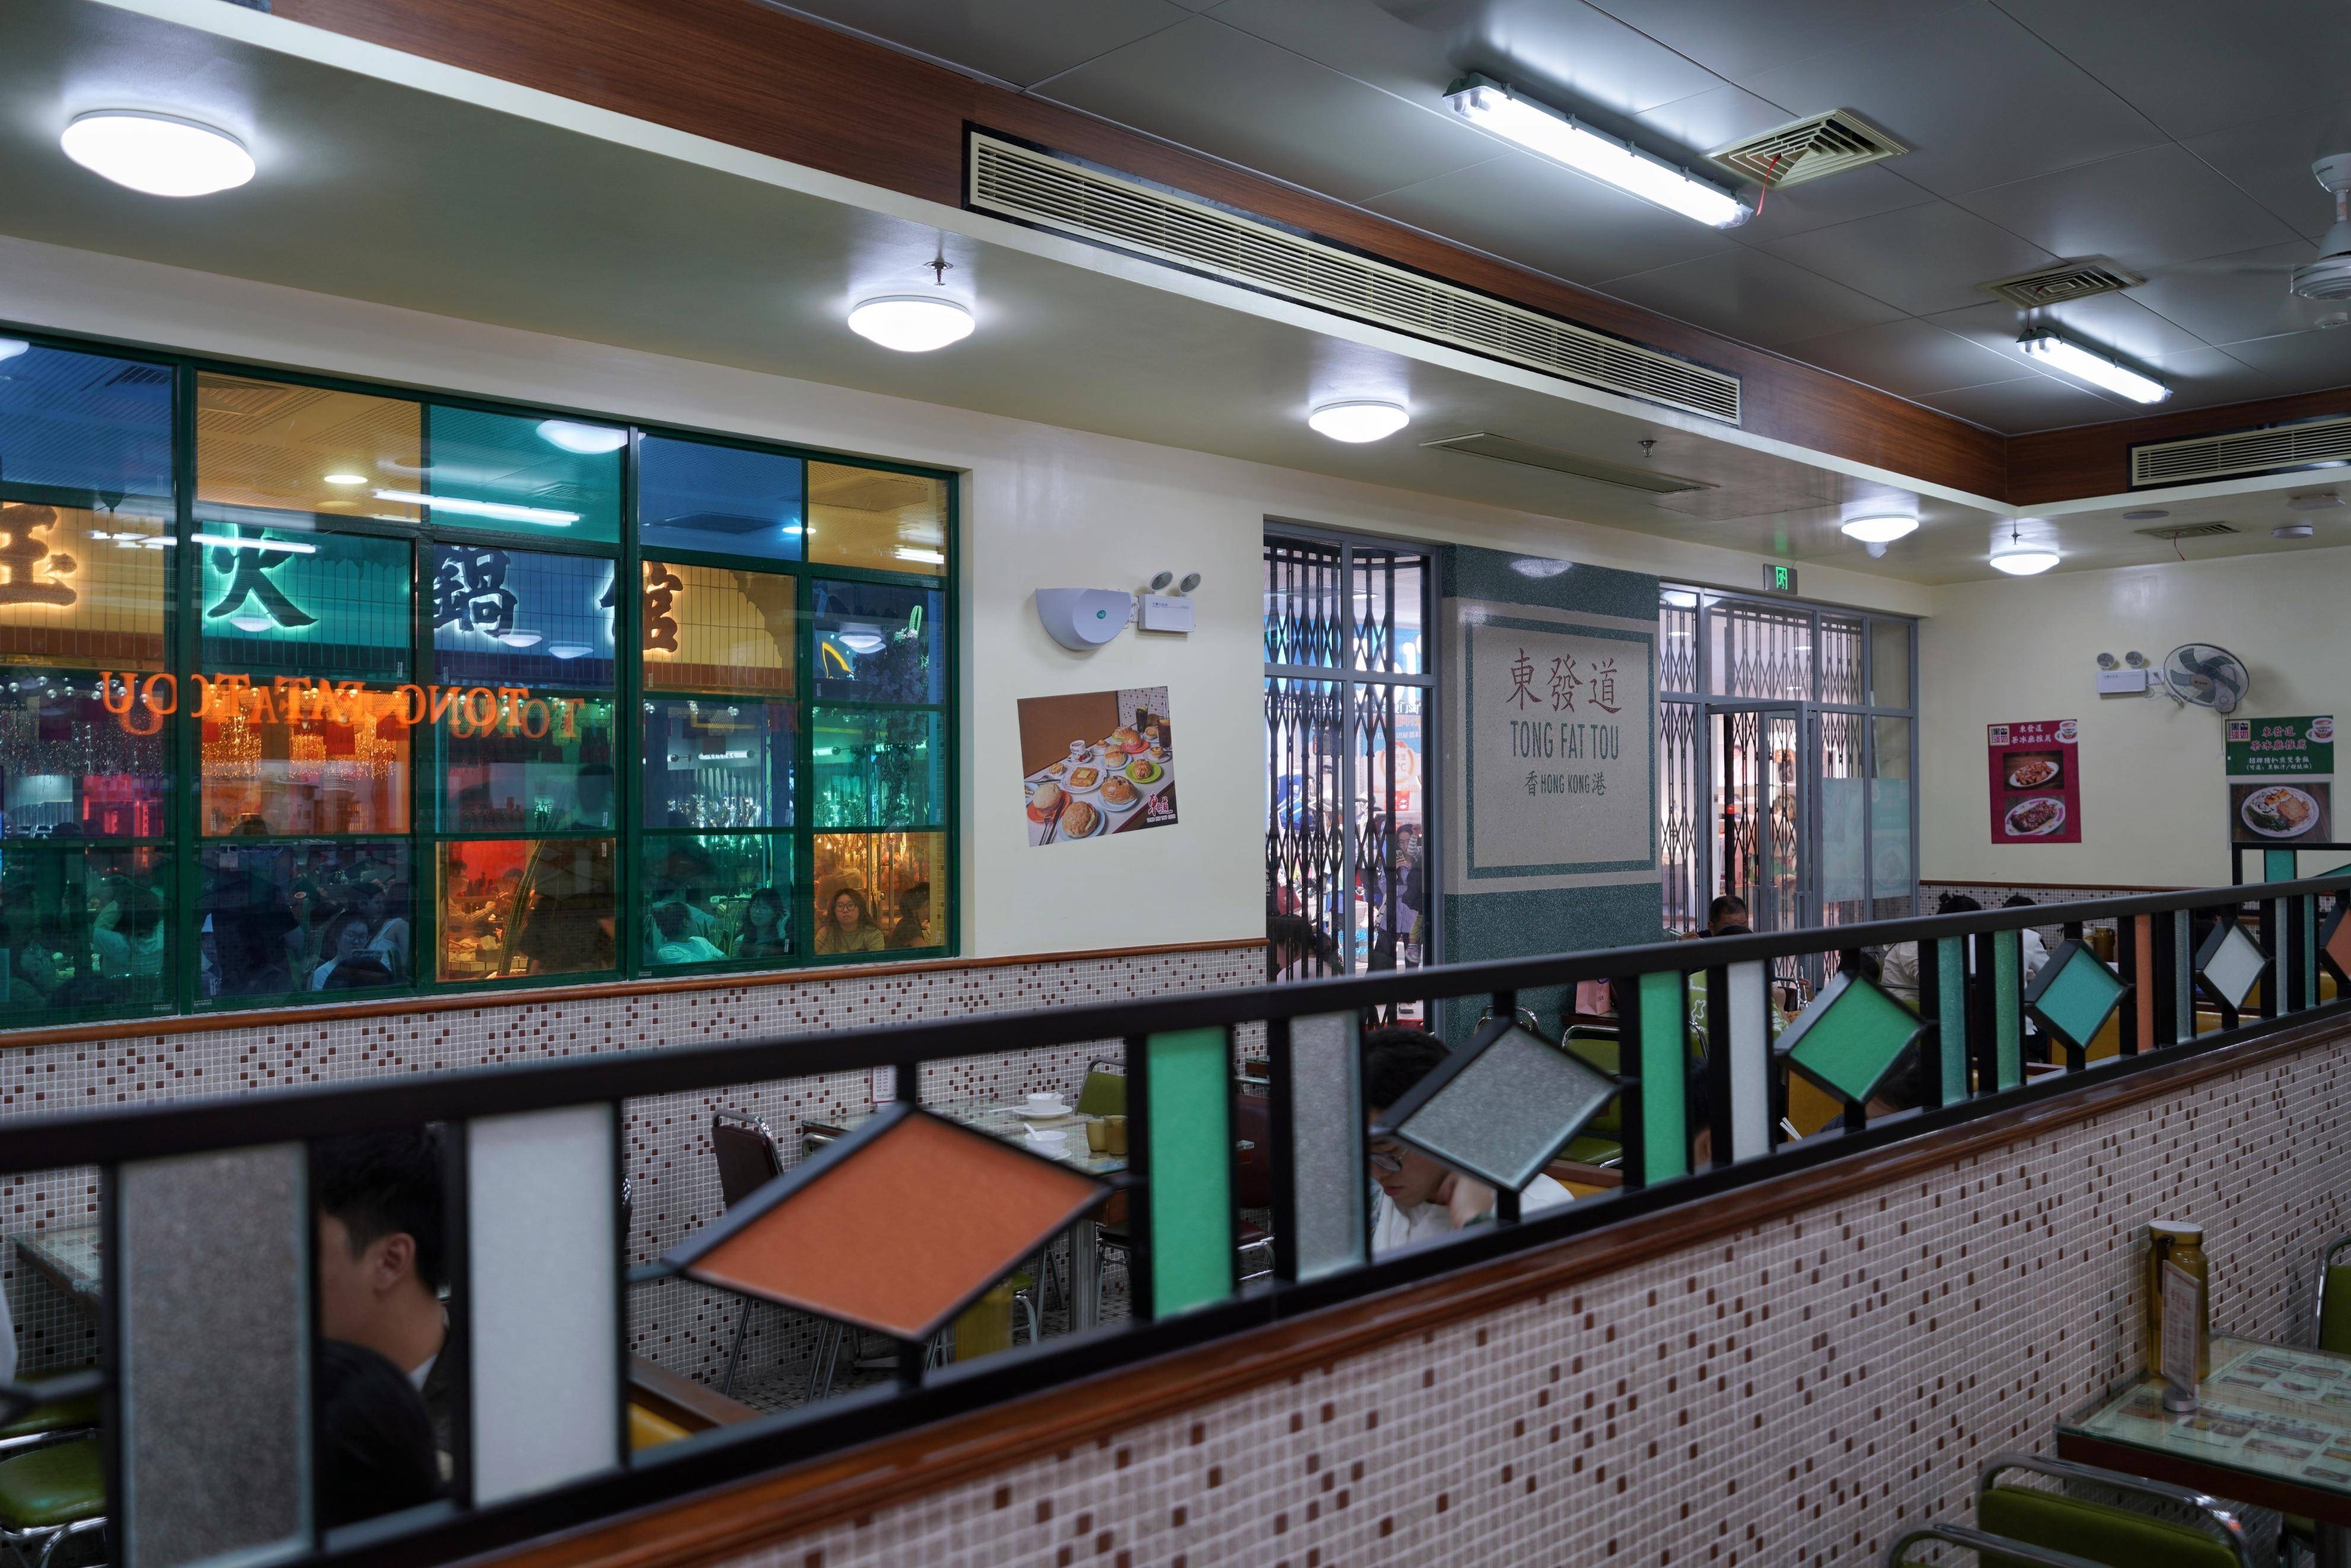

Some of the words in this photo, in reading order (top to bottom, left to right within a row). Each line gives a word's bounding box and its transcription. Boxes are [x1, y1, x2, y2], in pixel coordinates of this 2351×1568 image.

[1506, 647, 1622, 713] 東發道
[1511, 721, 1553, 758] TONG
[1561, 723, 1585, 759] FAT
[1591, 724, 1619, 760] TOU
[2019, 724, 2043, 733] 東發道
[2261, 726, 2296, 737] 東發道
[1524, 770, 1538, 797] 香
[1541, 774, 1565, 794] HONG
[1568, 775, 1589, 794] KONG
[1592, 772, 1607, 796] 港
